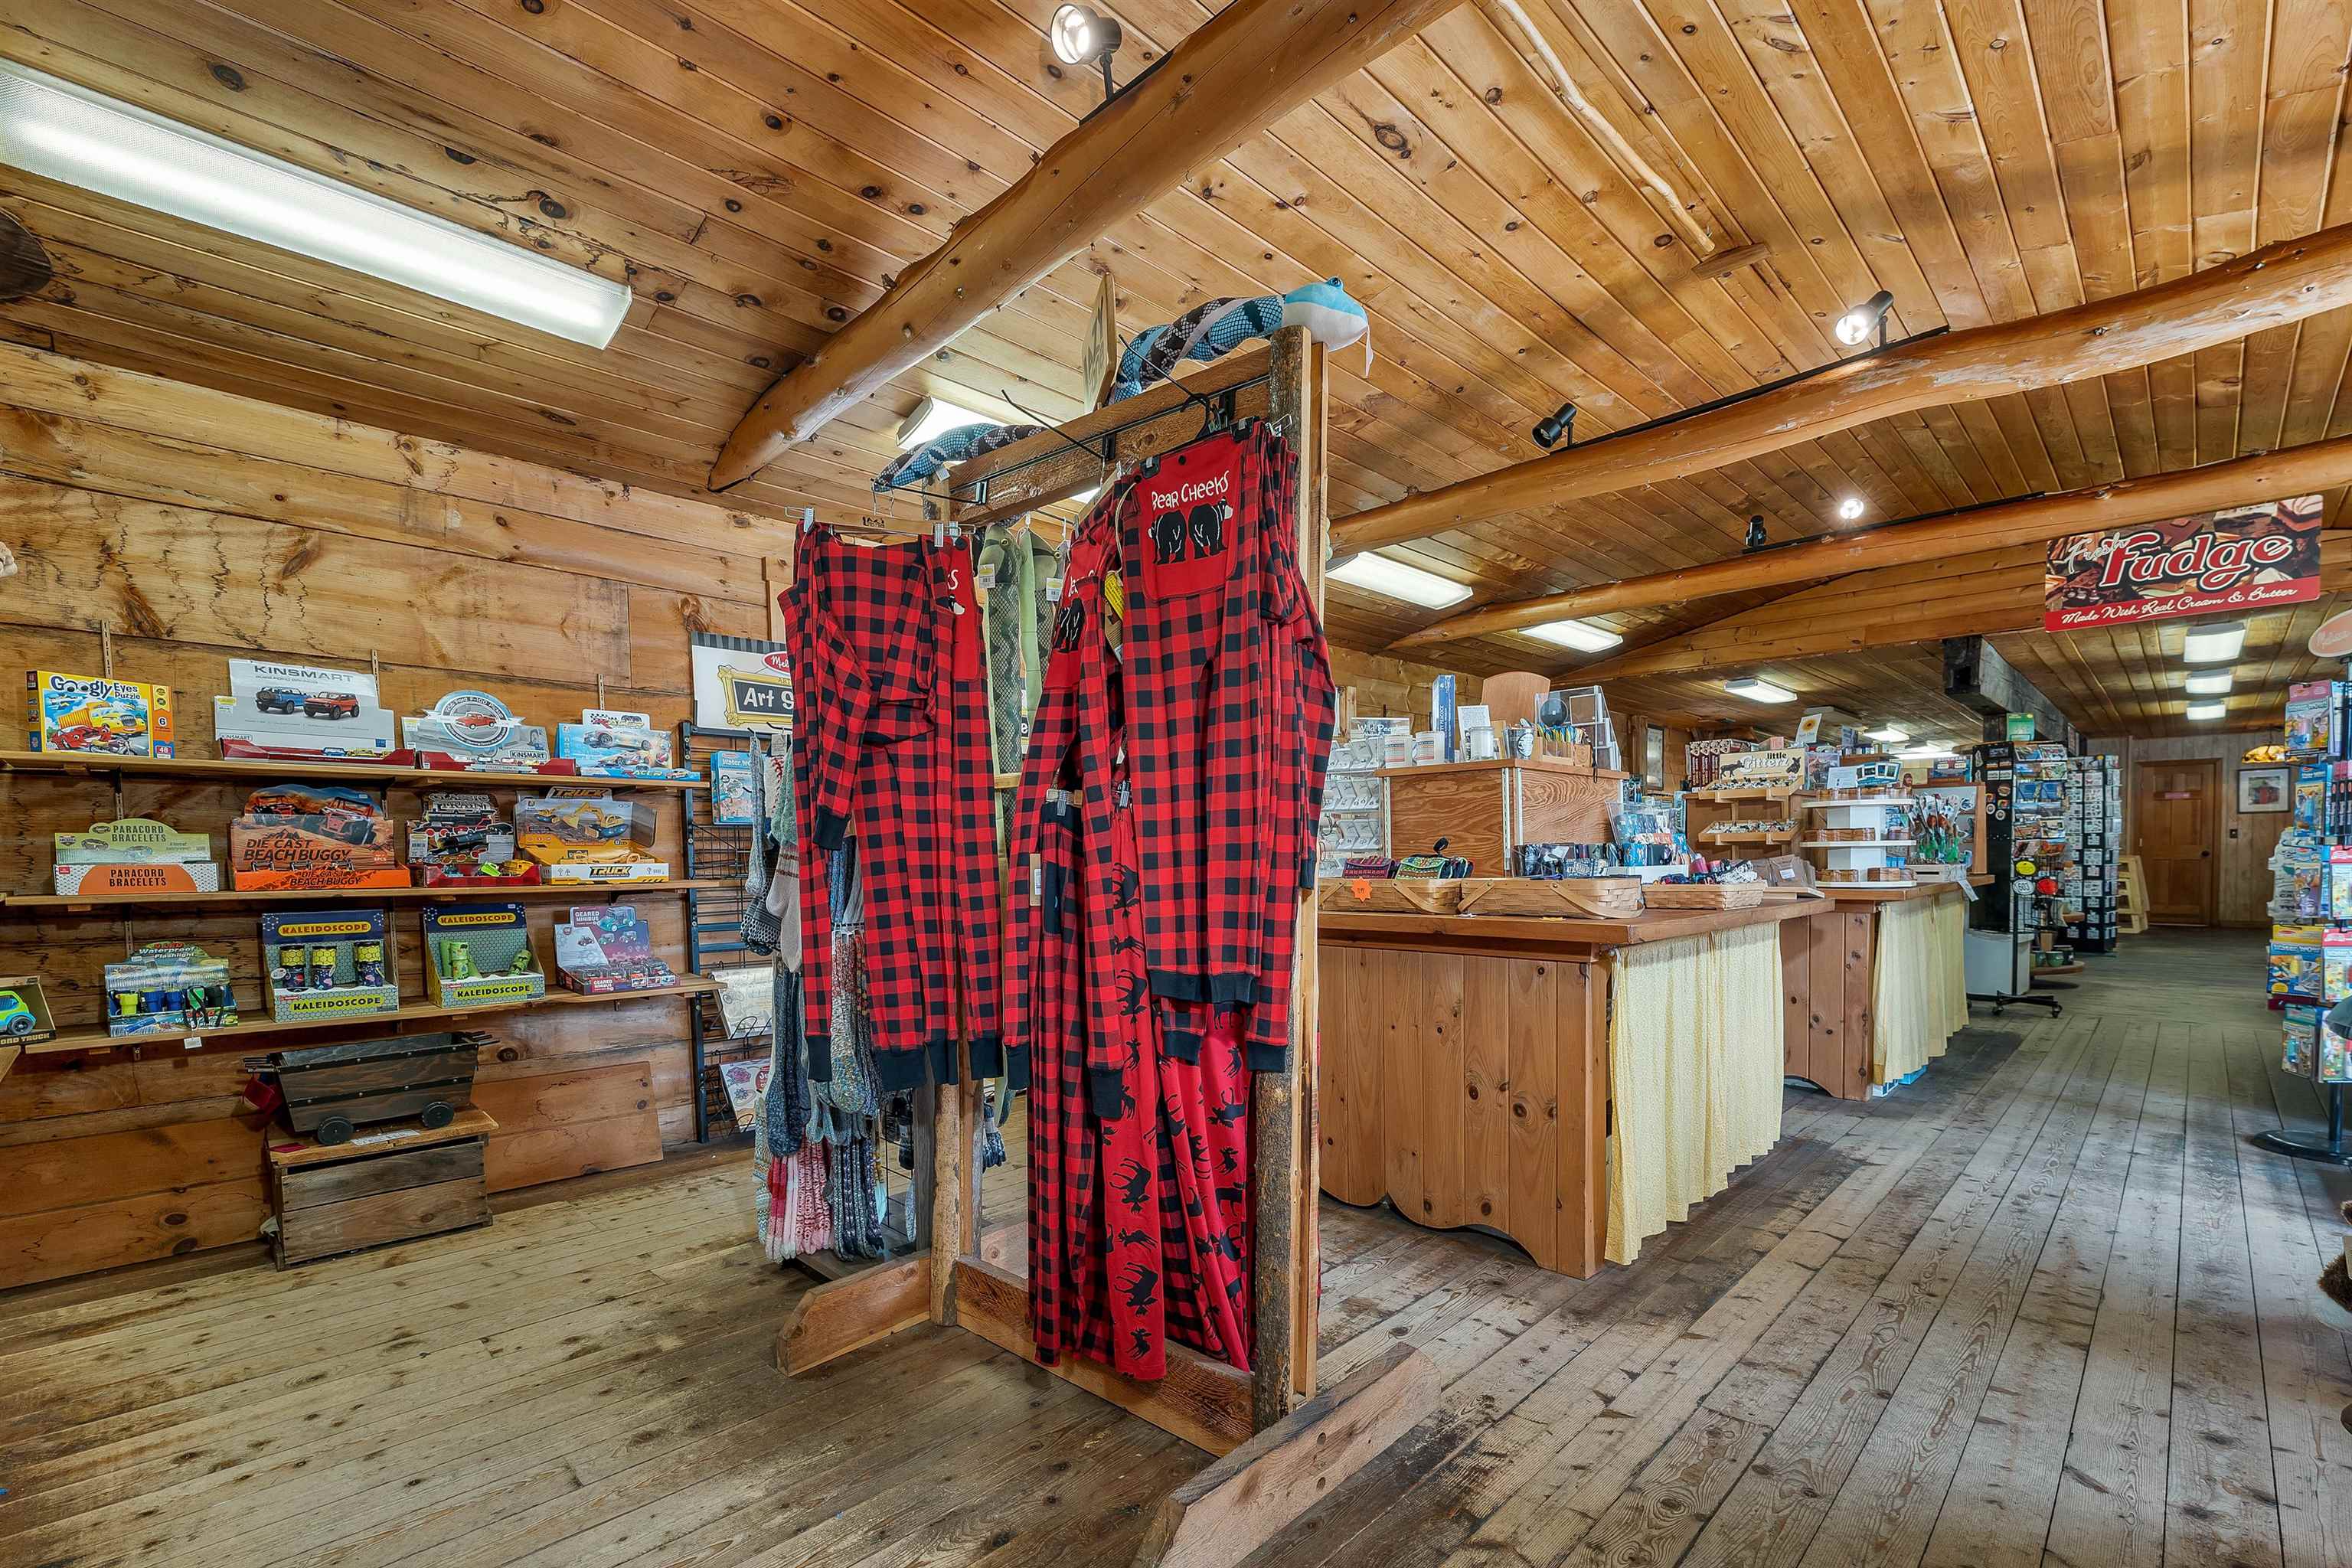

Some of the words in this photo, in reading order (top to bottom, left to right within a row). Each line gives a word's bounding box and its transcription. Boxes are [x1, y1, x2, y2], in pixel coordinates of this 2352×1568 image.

[2064, 531, 2128, 574] Fresh
[2099, 531, 2296, 591] Fudge
[2061, 609, 2101, 625] Made
[2102, 606, 2140, 620] With
[2138, 600, 2177, 617] Real
[2177, 596, 2225, 610] Cream
[2227, 591, 2246, 603] &
[2247, 586, 2298, 602] Butter
[254, 665, 354, 683] KINSMART
[50, 675, 113, 699] Googly
[114, 682, 138, 693] Eyes
[114, 691, 141, 700] Puzzle
[743, 687, 776, 707] Art
[158, 717, 166, 726] 6
[158, 746, 168, 754] 48
[554, 789, 606, 799] TRUCK
[113, 825, 165, 834] PARACORD
[111, 834, 167, 842] BRACELETS
[247, 838, 273, 849] DIE
[273, 838, 314, 849] CAST
[243, 849, 296, 861] BEACH
[297, 848, 352, 862] BUGGY
[110, 868, 165, 878] PARACORD
[590, 866, 632, 877] TRUCK
[109, 877, 167, 887] BRACELETS
[289, 877, 325, 887] BEACH
[325, 877, 361, 886] BUGGY
[440, 913, 514, 925] KALEIDOSCOPE
[281, 923, 368, 935] KALEIDOSCOPE
[139, 946, 197, 956] Waterproof
[456, 984, 531, 998] KALEIDOSCOPE
[293, 996, 381, 1011] KALEIDOSCOPE
[21, 1033, 50, 1042] TRUCK
